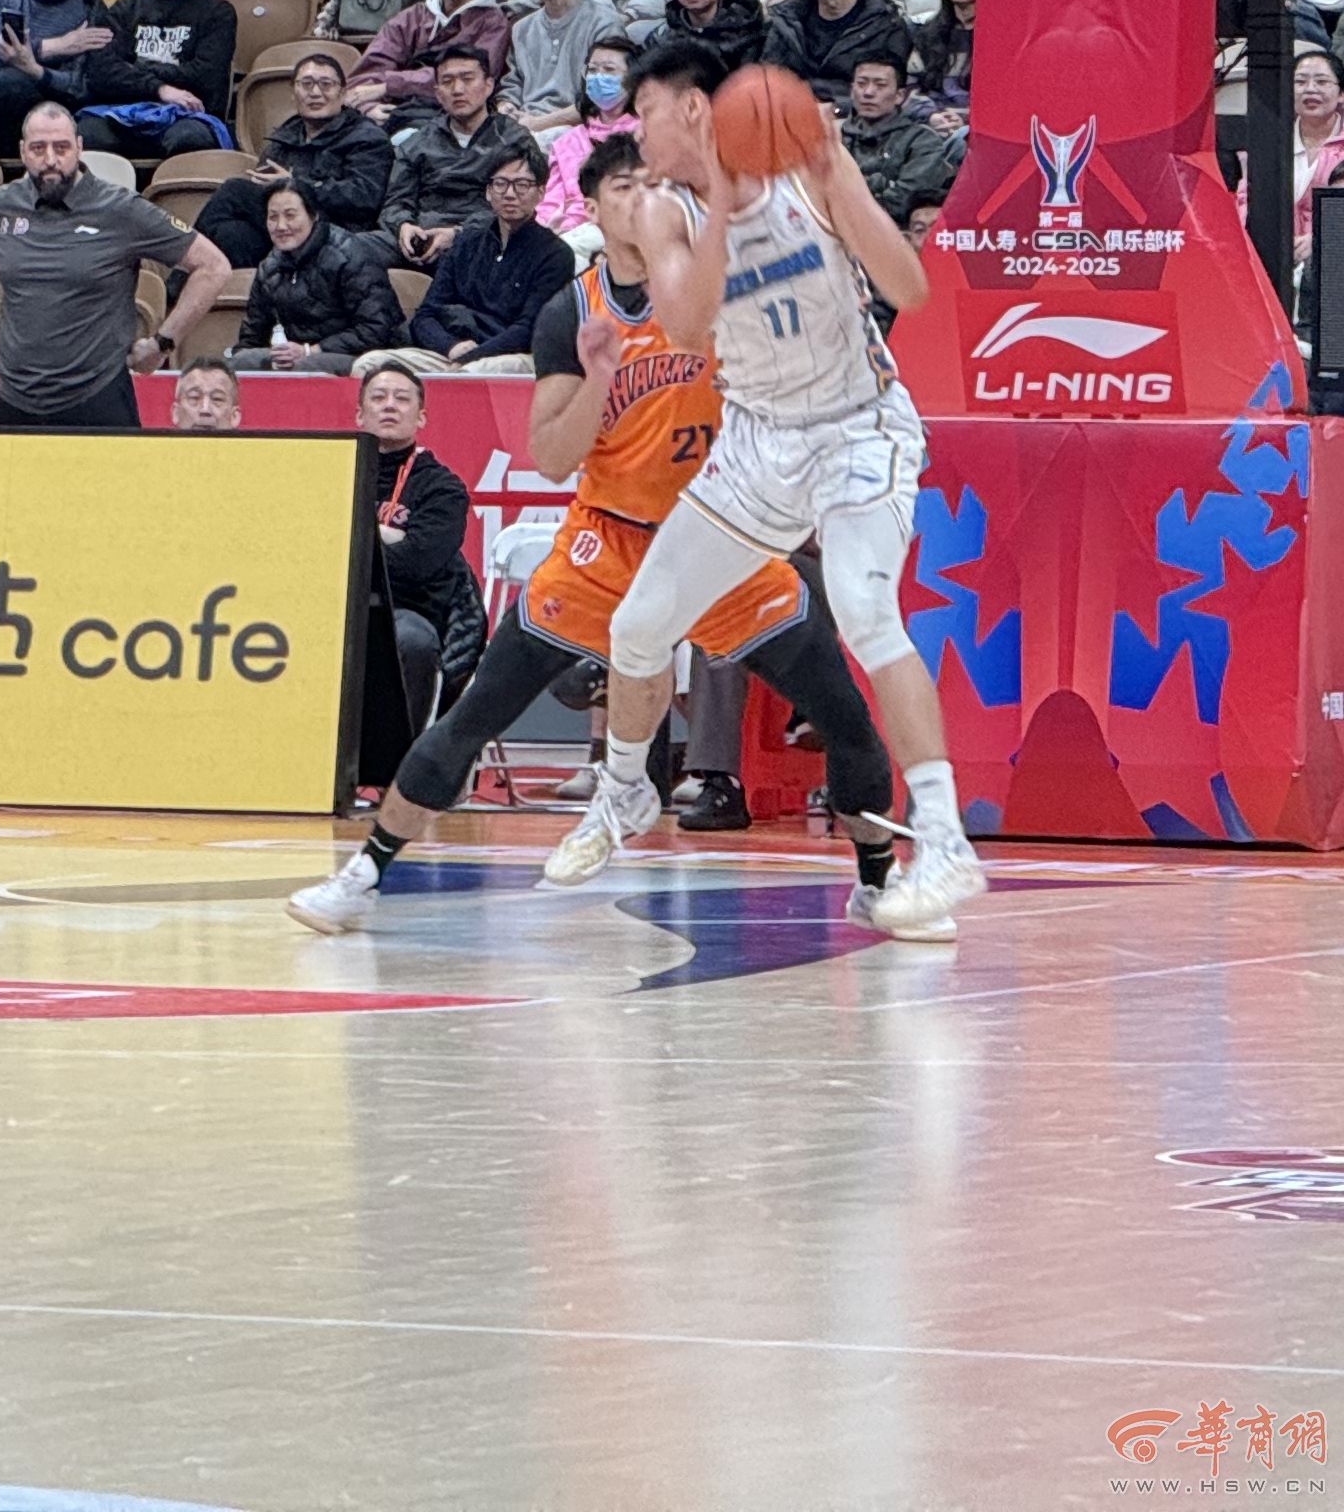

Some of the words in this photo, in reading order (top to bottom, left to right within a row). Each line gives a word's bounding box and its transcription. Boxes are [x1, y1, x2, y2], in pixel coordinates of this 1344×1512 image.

[1039, 211, 1082, 228] 第一届
[1002, 257, 1120, 276] 2024-2025
[762, 298, 800, 339] 17
[975, 372, 1172, 403] LI-NING
[671, 424, 712, 463] 21
[62, 585, 289, 683] cafe
